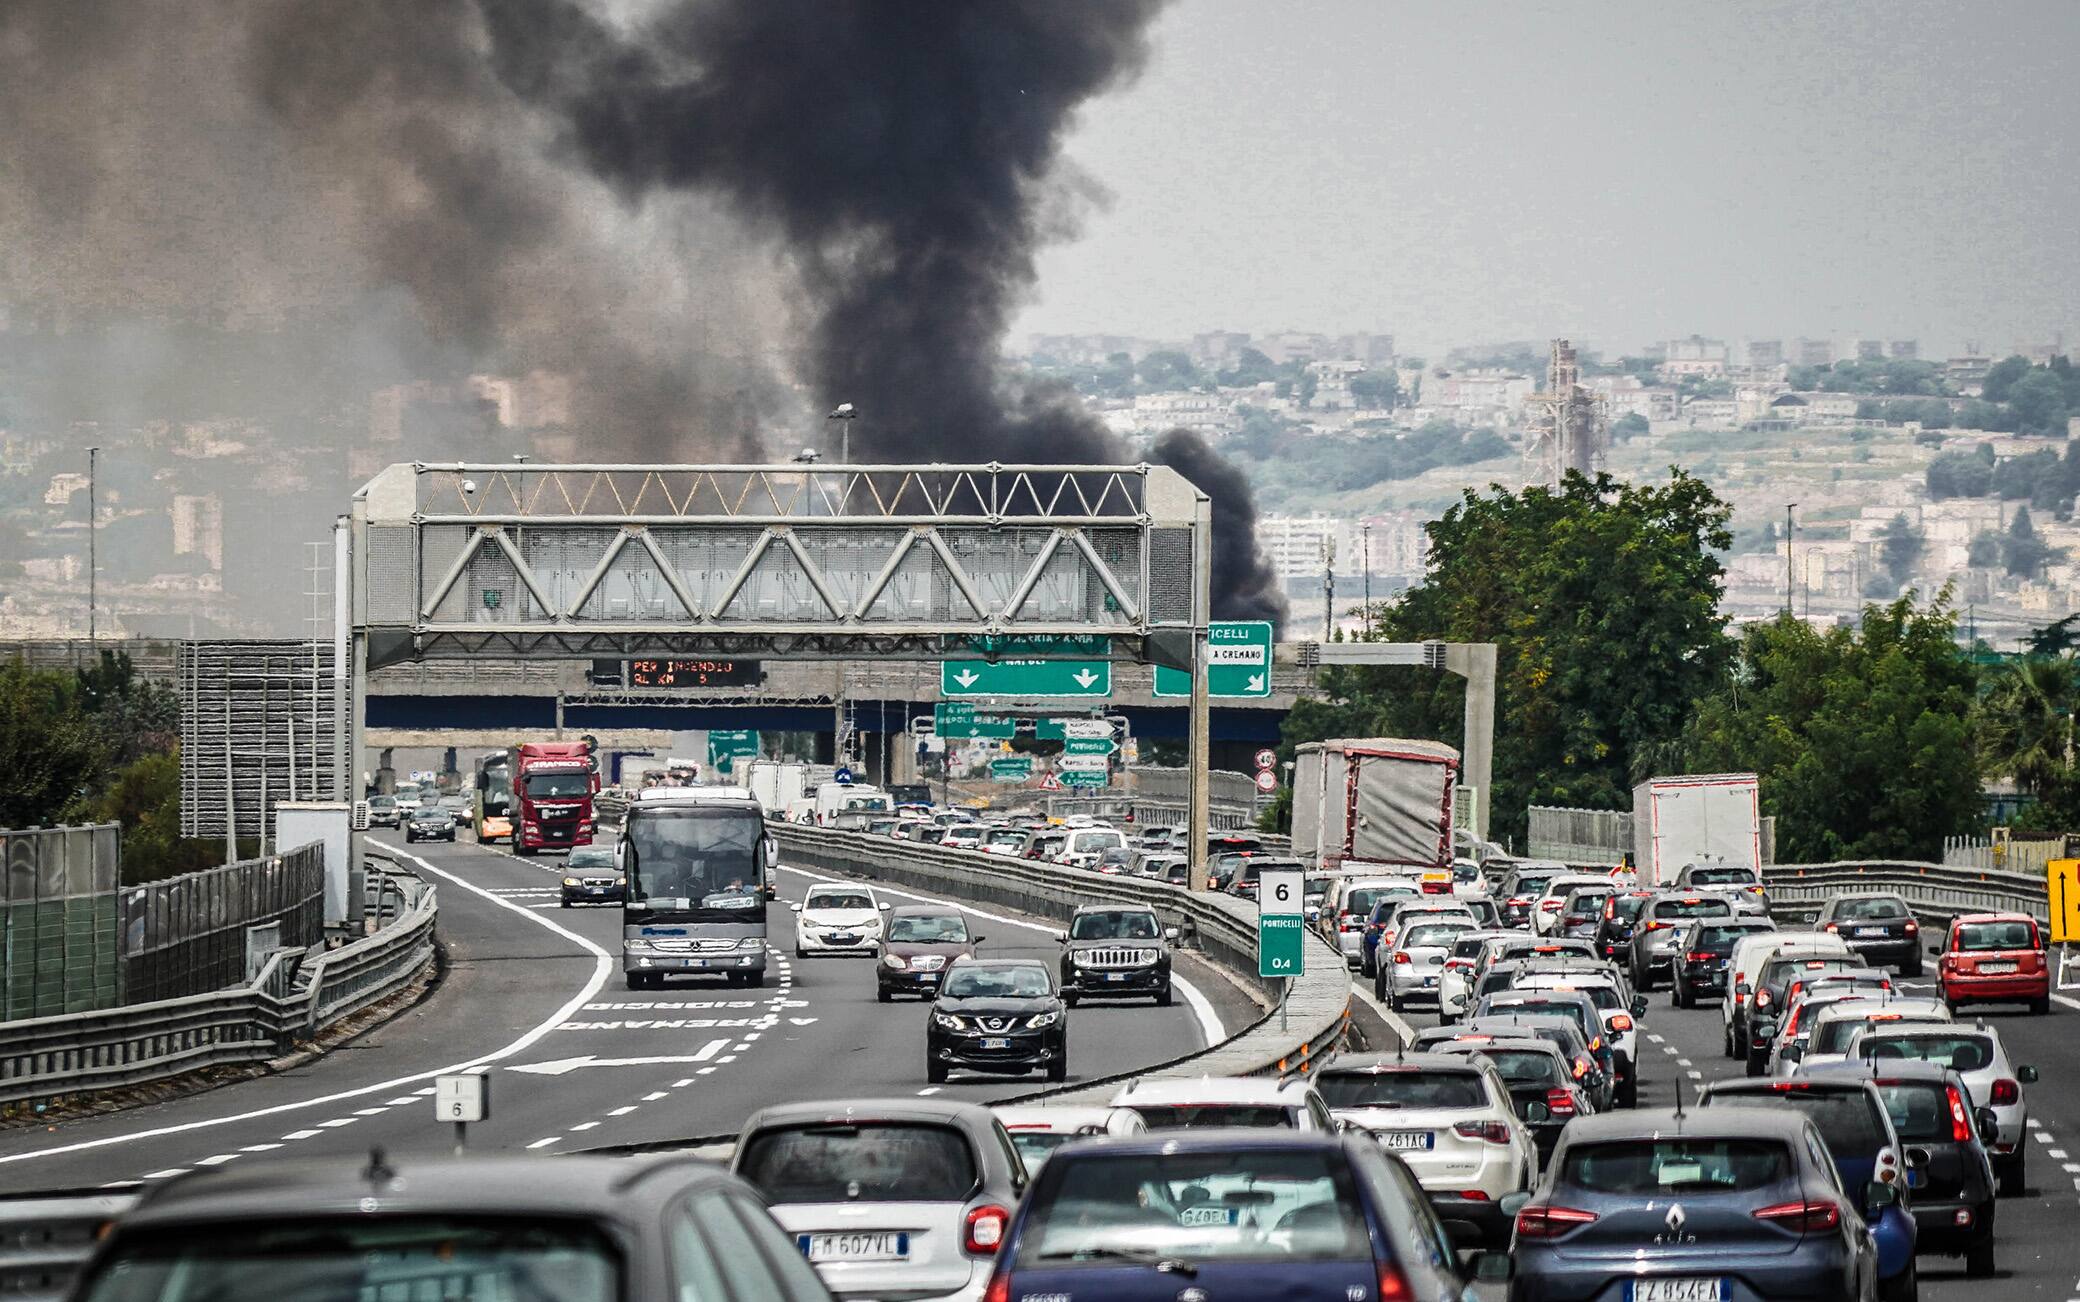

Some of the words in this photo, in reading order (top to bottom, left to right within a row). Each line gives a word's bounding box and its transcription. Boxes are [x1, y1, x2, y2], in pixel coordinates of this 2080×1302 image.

[1222, 650, 1261, 659] CREMANO
[1275, 883, 1289, 902] 6
[1263, 919, 1301, 929] PONTICELLI
[453, 1103, 461, 1117] 6
[1388, 1133, 1426, 1148] 461AC
[840, 1233, 894, 1255] 607VL
